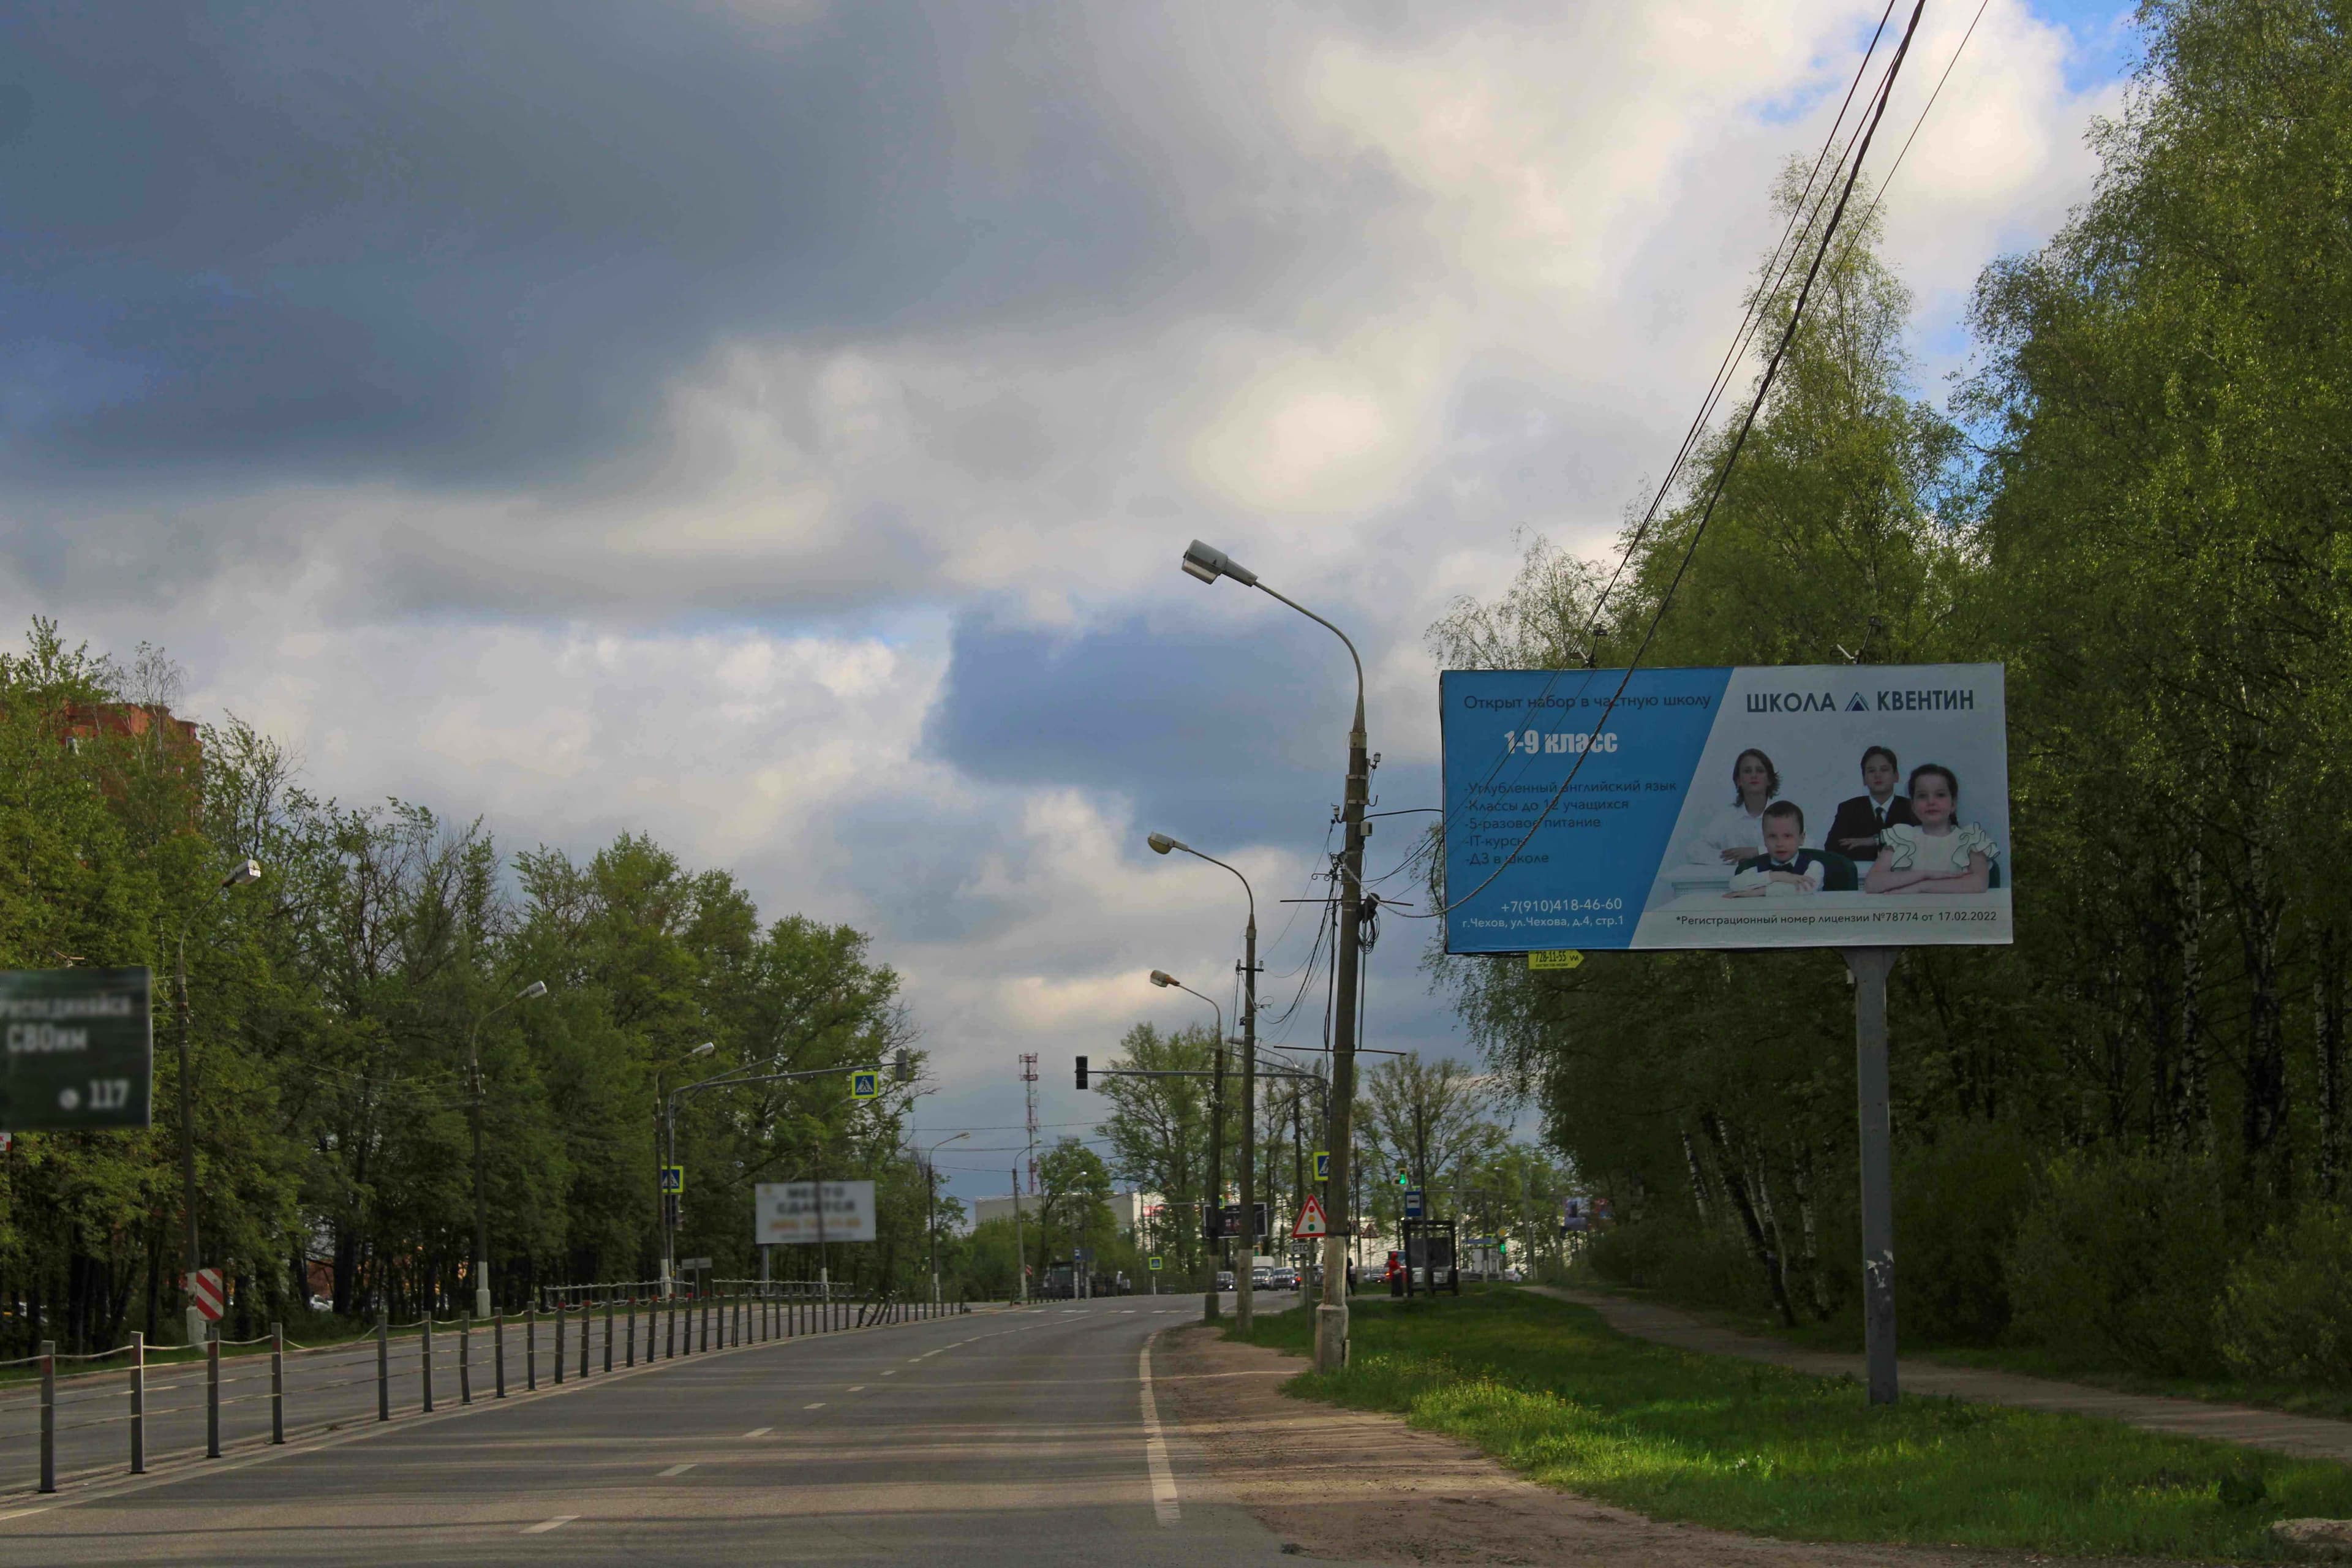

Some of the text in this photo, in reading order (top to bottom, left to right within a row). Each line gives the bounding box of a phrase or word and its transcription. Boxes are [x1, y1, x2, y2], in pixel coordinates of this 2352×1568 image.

[1464, 695, 1523, 712] Открыт
[1528, 695, 1576, 710] набор
[1581, 697, 1589, 707] в
[1664, 695, 1712, 709] школу
[1746, 690, 1974, 712] ШКОЛА КВЕНТИН
[1504, 729, 1618, 754] 1-9 класс
[1645, 781, 1677, 791] язык
[1465, 799, 1518, 812] -Классы
[1521, 801, 1539, 812] до
[1563, 800, 1629, 813] учащихся
[1545, 818, 1601, 827] питание
[1494, 856, 1501, 864] в
[1501, 897, 1623, 914] +7(910)418-46-60
[1462, 914, 1624, 930] г.Чехов, ул.Чехова, д.4, стр.1
[1781, 915, 1815, 925] номер
[1819, 914, 1869, 923] лицензии
[1921, 913, 1934, 922] от
[1939, 911, 1997, 921] 17.02.2022
[1535, 950, 1567, 962] 728-11-55
